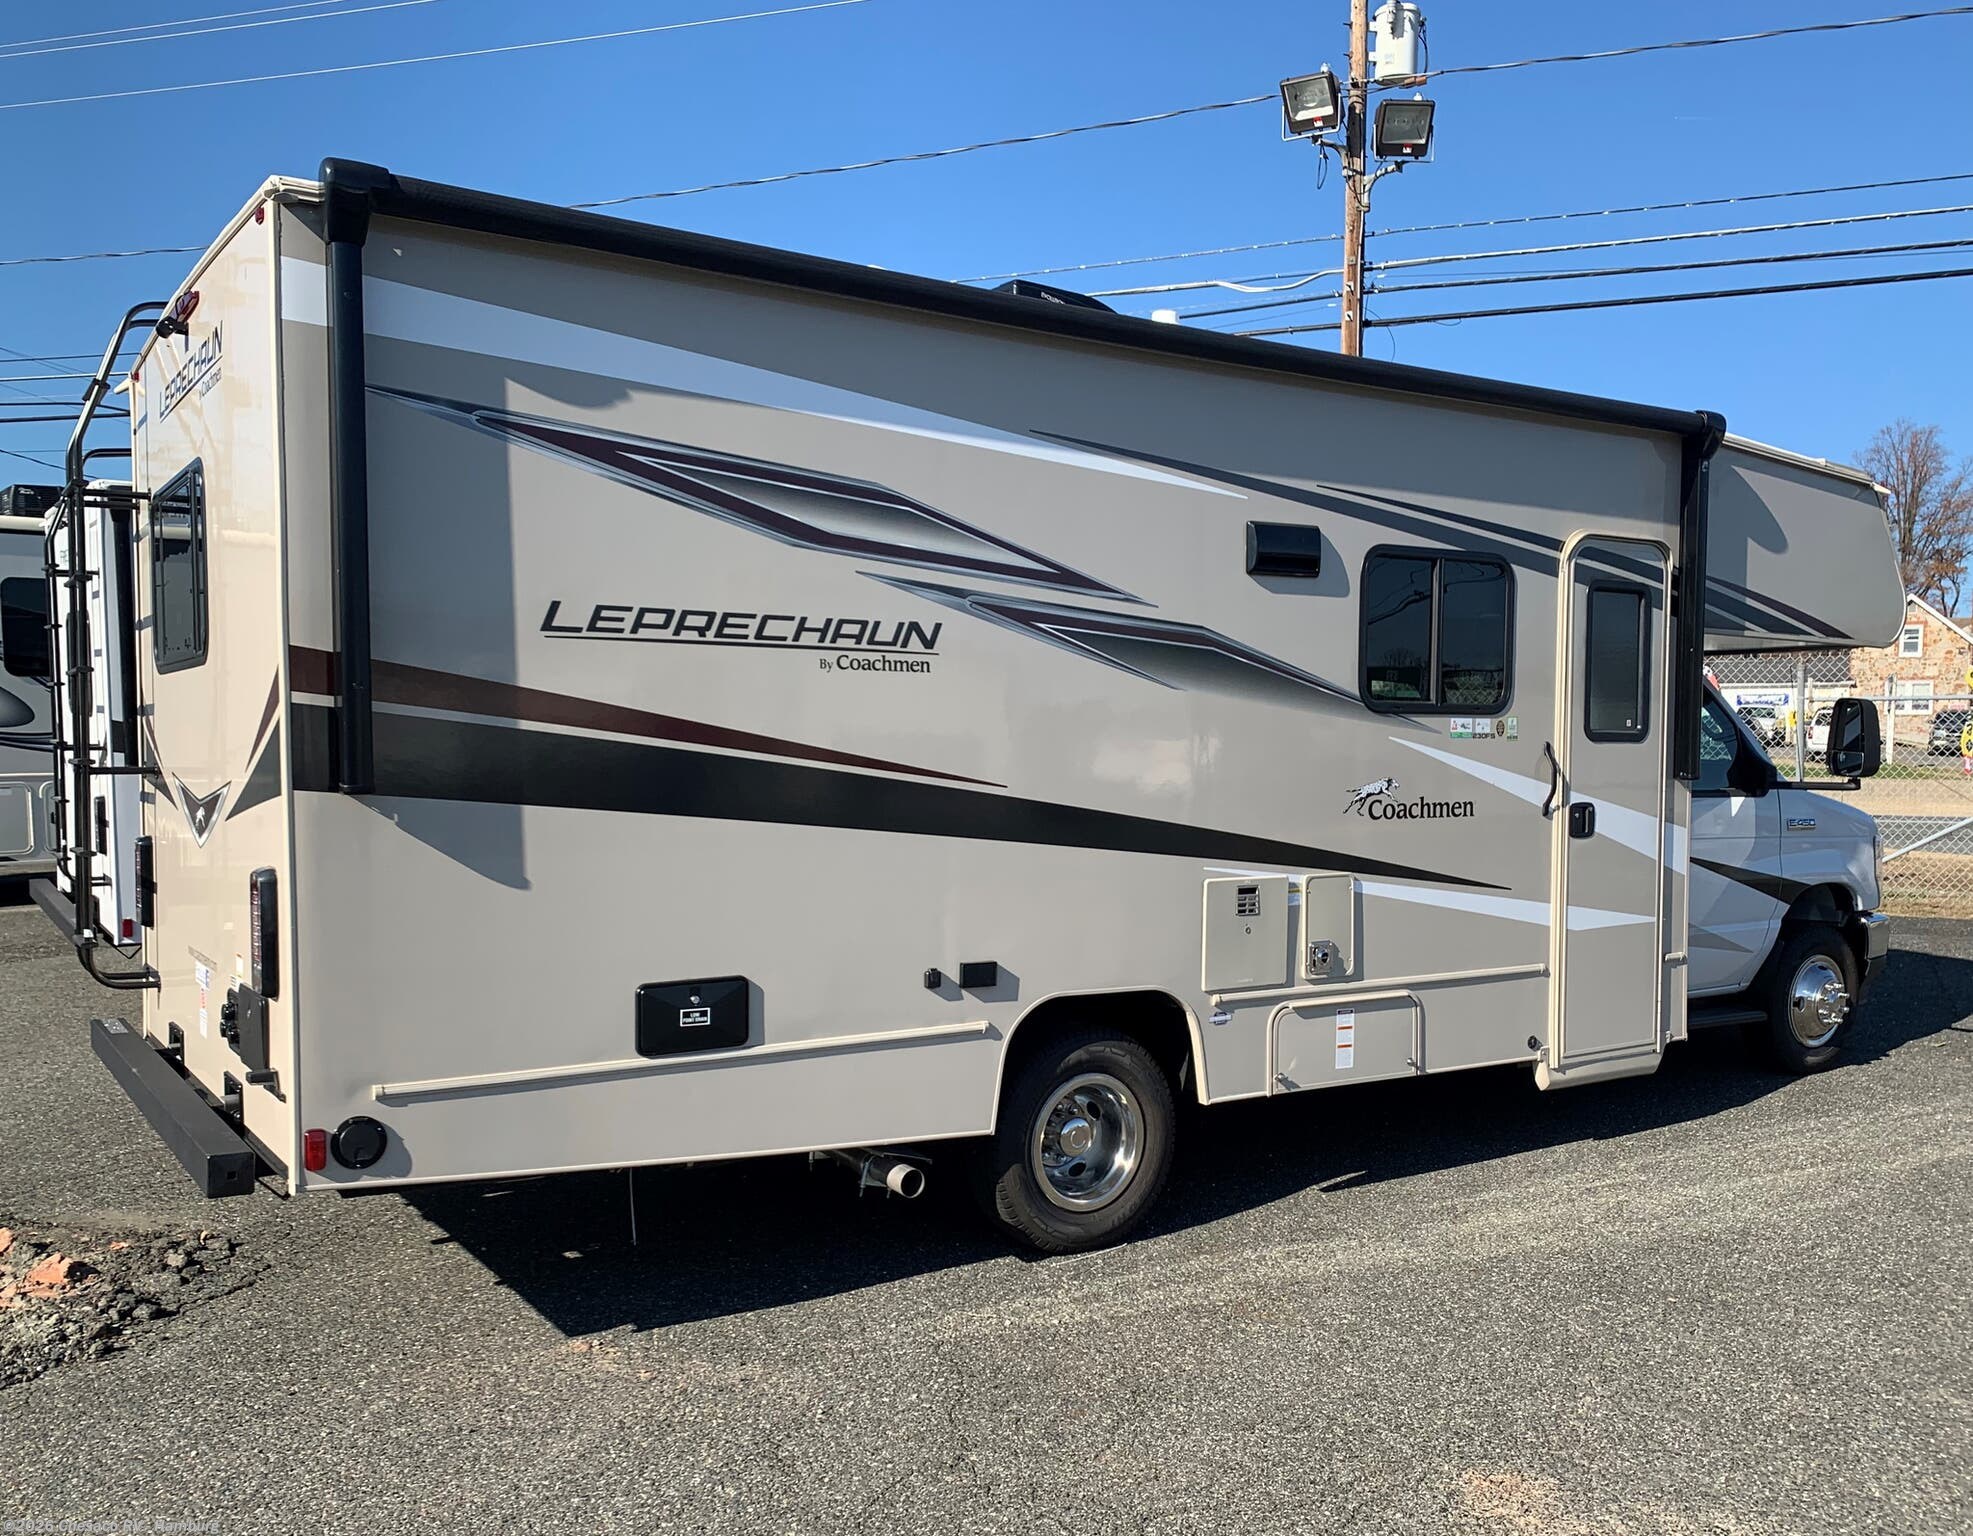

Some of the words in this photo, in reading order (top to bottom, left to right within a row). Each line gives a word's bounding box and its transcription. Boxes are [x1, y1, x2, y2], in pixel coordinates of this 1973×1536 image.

[159, 319, 223, 419] LEPRECHAUN
[540, 599, 943, 650] LEPRECHAUN
[819, 658, 833, 673] By
[836, 655, 931, 673] Coachmen
[1368, 796, 1475, 820] Coachmen
